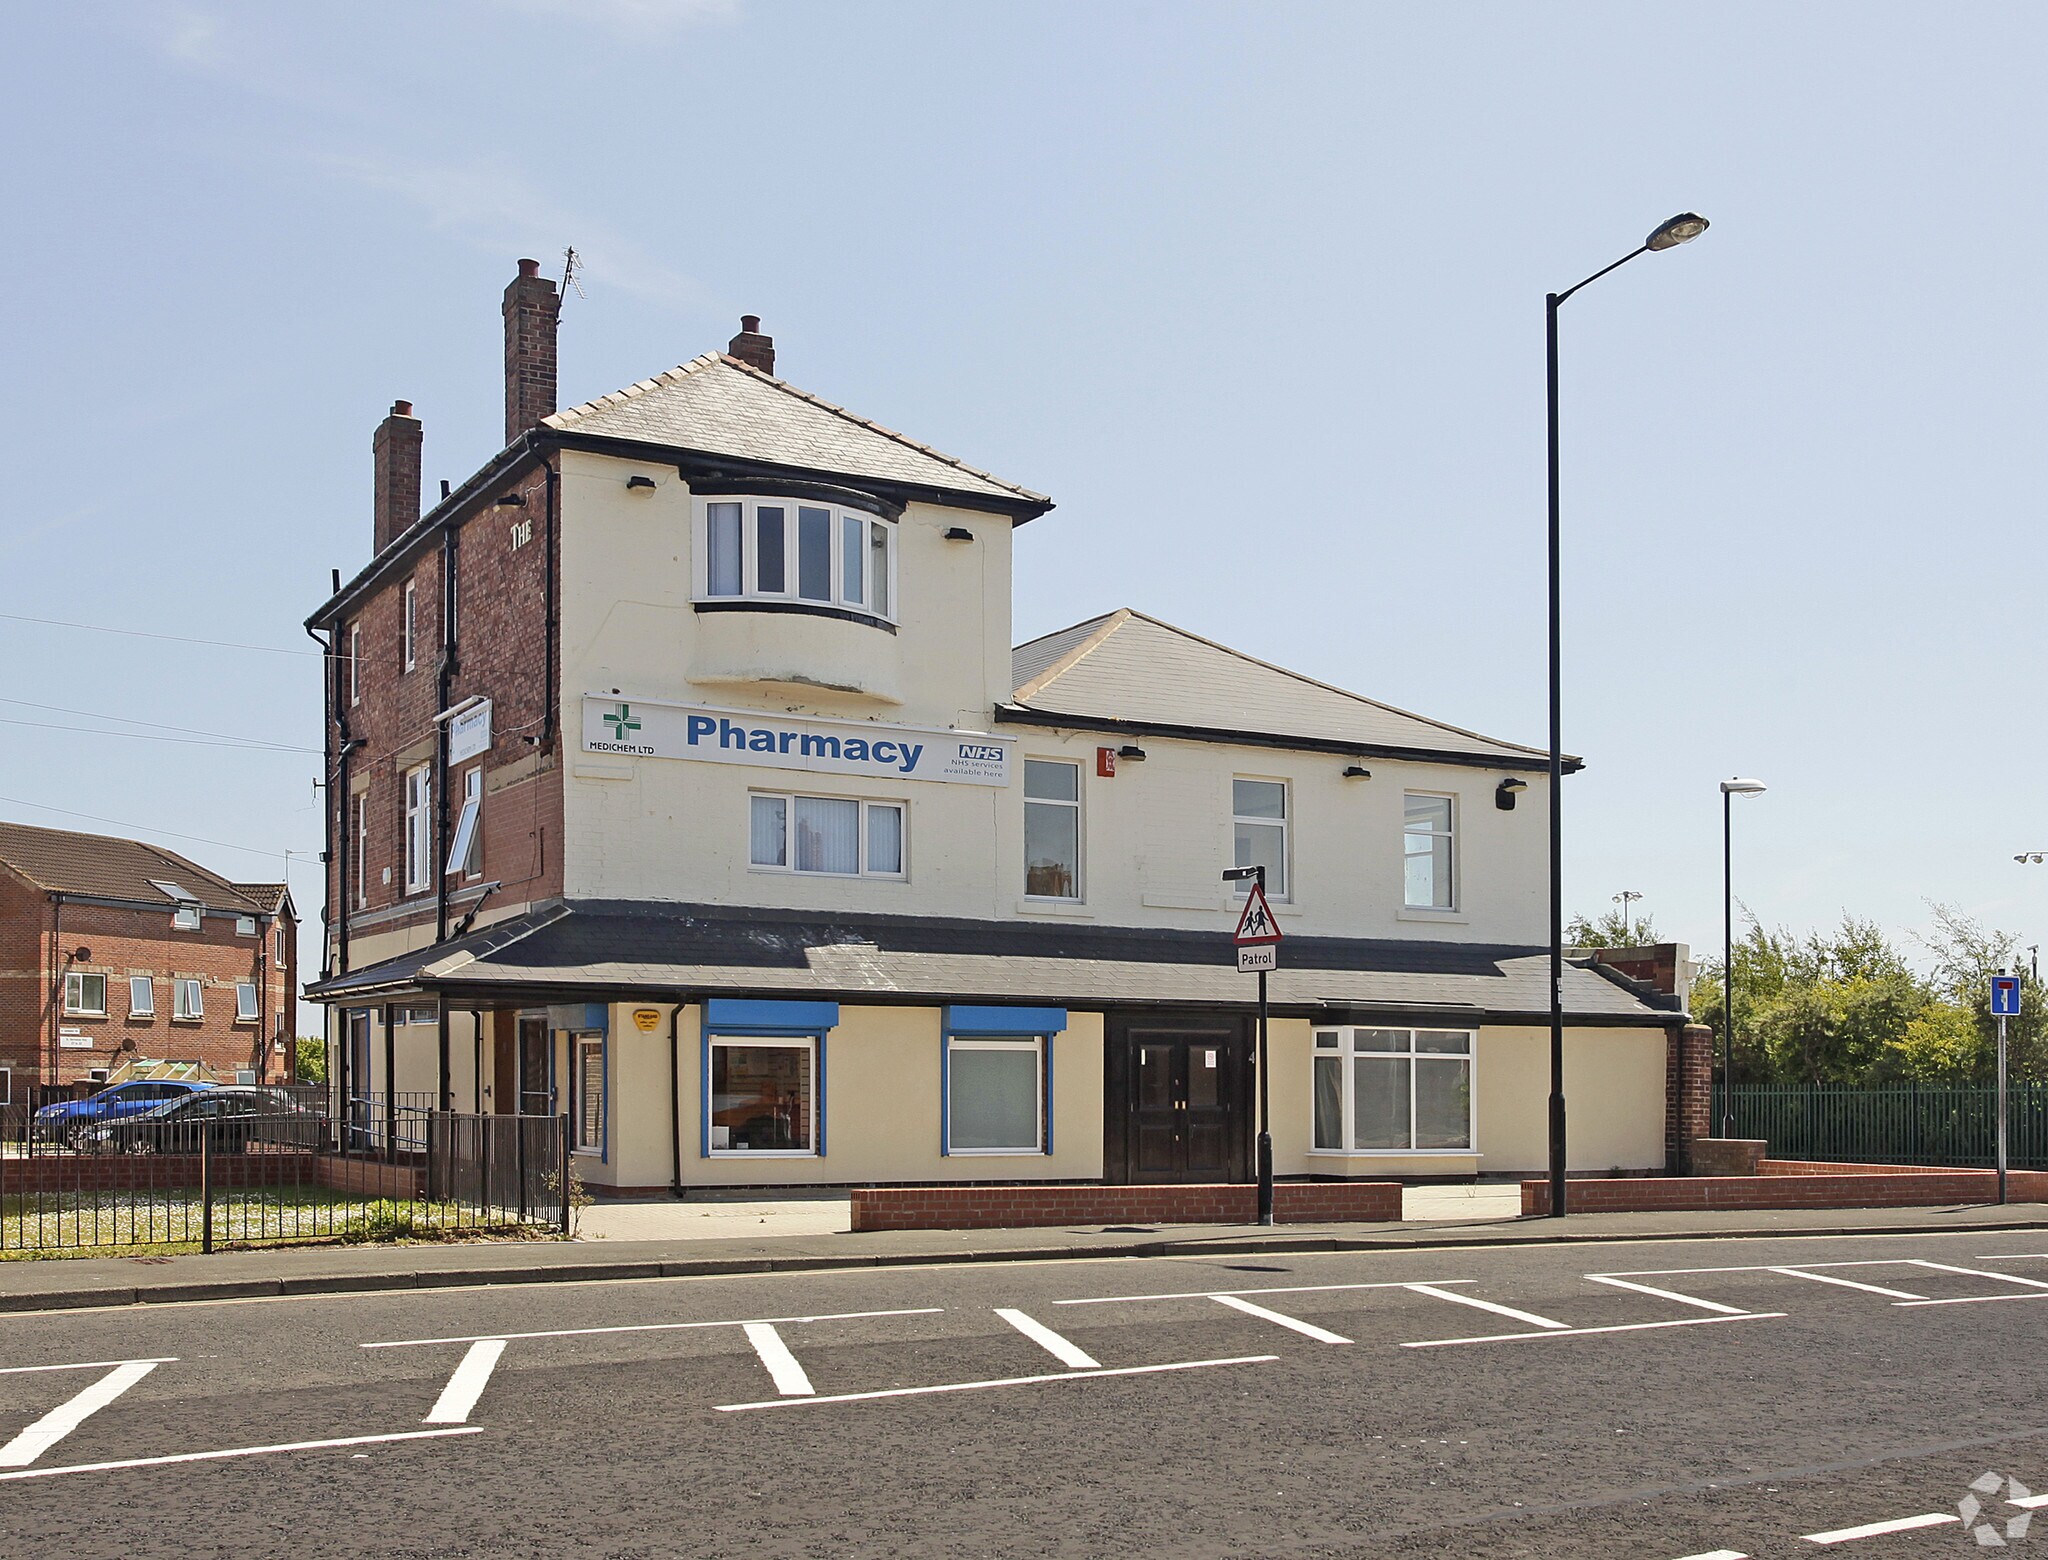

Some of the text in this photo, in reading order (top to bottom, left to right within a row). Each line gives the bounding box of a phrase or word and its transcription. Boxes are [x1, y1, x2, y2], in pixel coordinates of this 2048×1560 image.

[510, 519, 532, 552] THE
[589, 742, 655, 755] MEDICHEM LTD
[687, 715, 924, 773] Pharmacy
[960, 745, 1002, 760] NHS
[951, 759, 969, 767] NHS
[943, 768, 1003, 778] available here
[1242, 952, 1272, 965] Patrol
